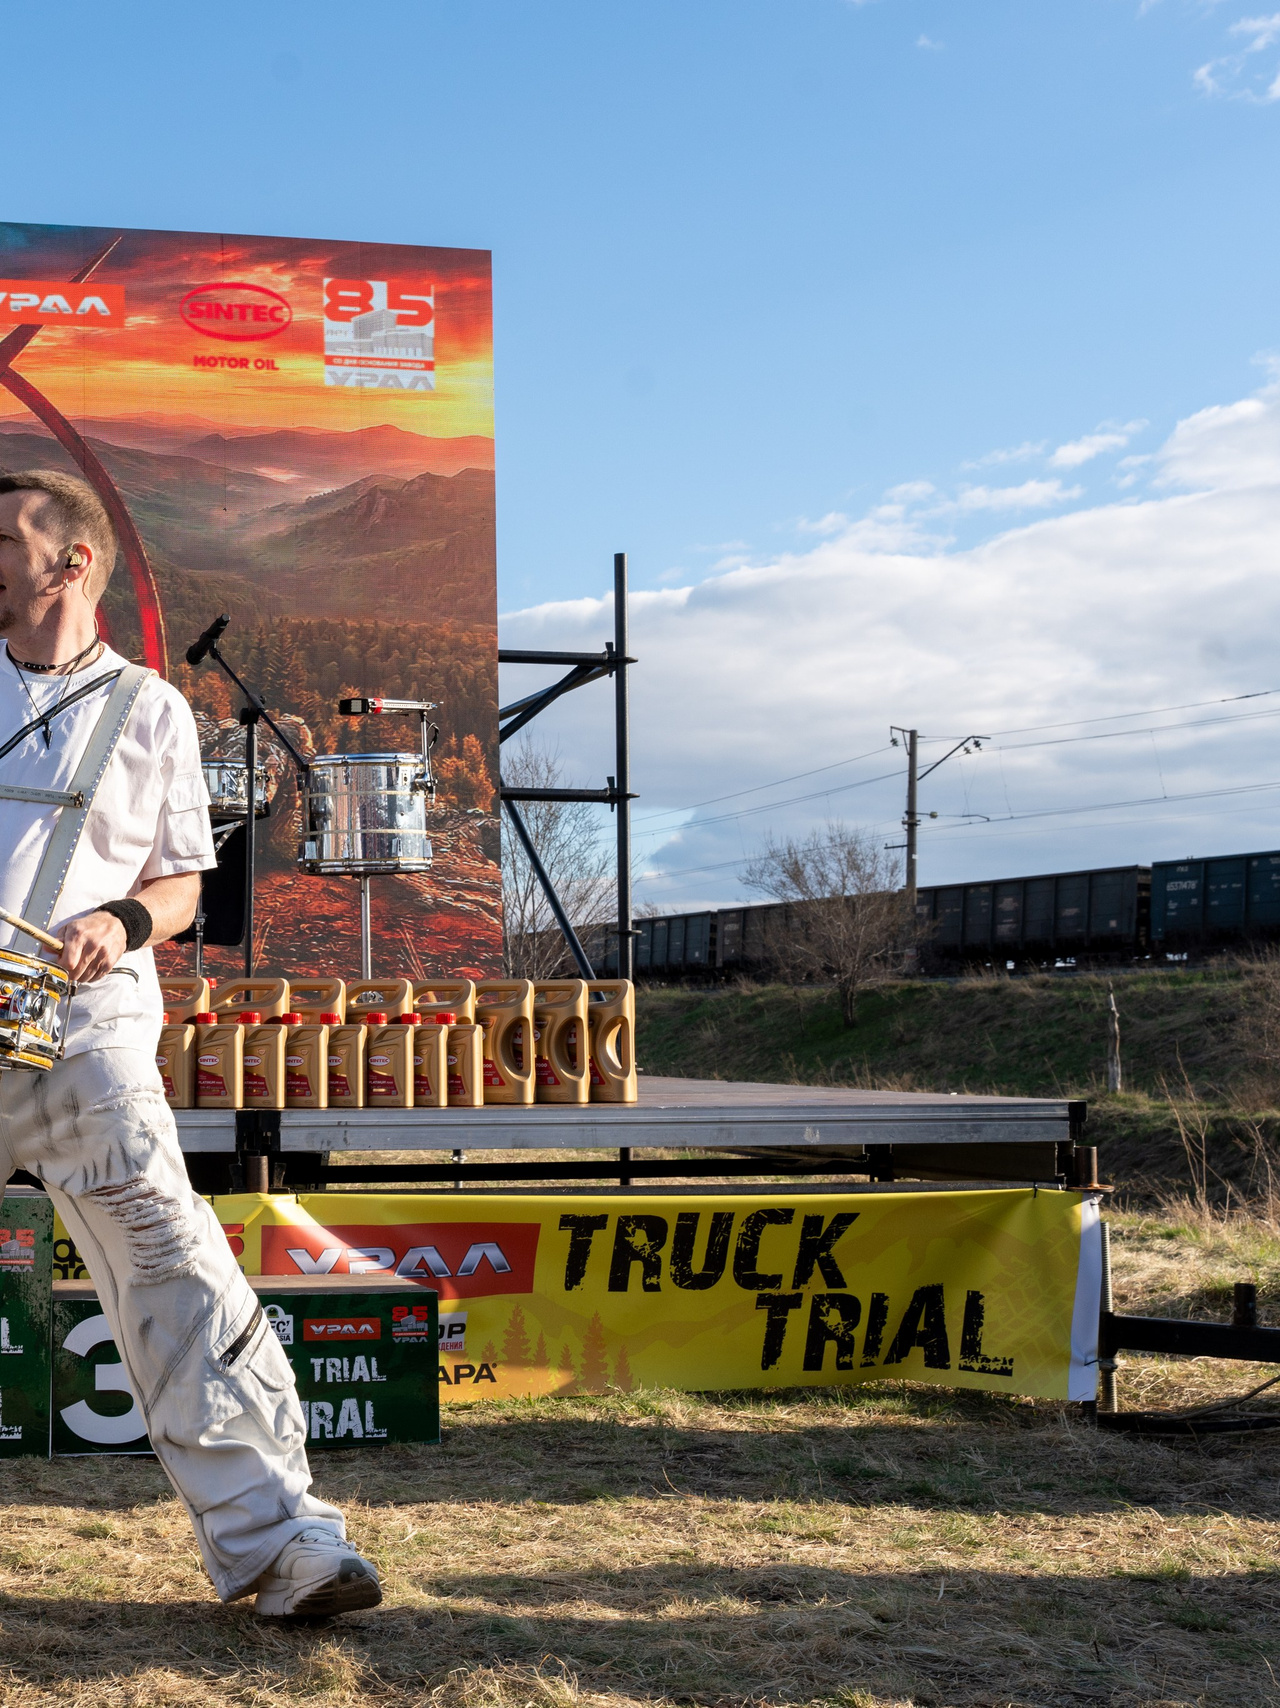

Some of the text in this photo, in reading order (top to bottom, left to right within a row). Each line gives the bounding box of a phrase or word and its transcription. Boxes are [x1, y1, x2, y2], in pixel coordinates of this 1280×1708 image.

[188, 302, 284, 323] SINTEC
[324, 279, 433, 327] 85
[193, 355, 279, 371] MOTOR OIL
[327, 371, 434, 390] УРАЛ
[285, 1242, 512, 1277] УРАЛ
[558, 1208, 860, 1292] TRUCK
[392, 1306, 428, 1322] 85
[310, 1323, 374, 1335] УРАЛ
[755, 1282, 1015, 1377] TRIAL
[59, 1314, 148, 1445] 3
[310, 1355, 387, 1382] TRIAL
